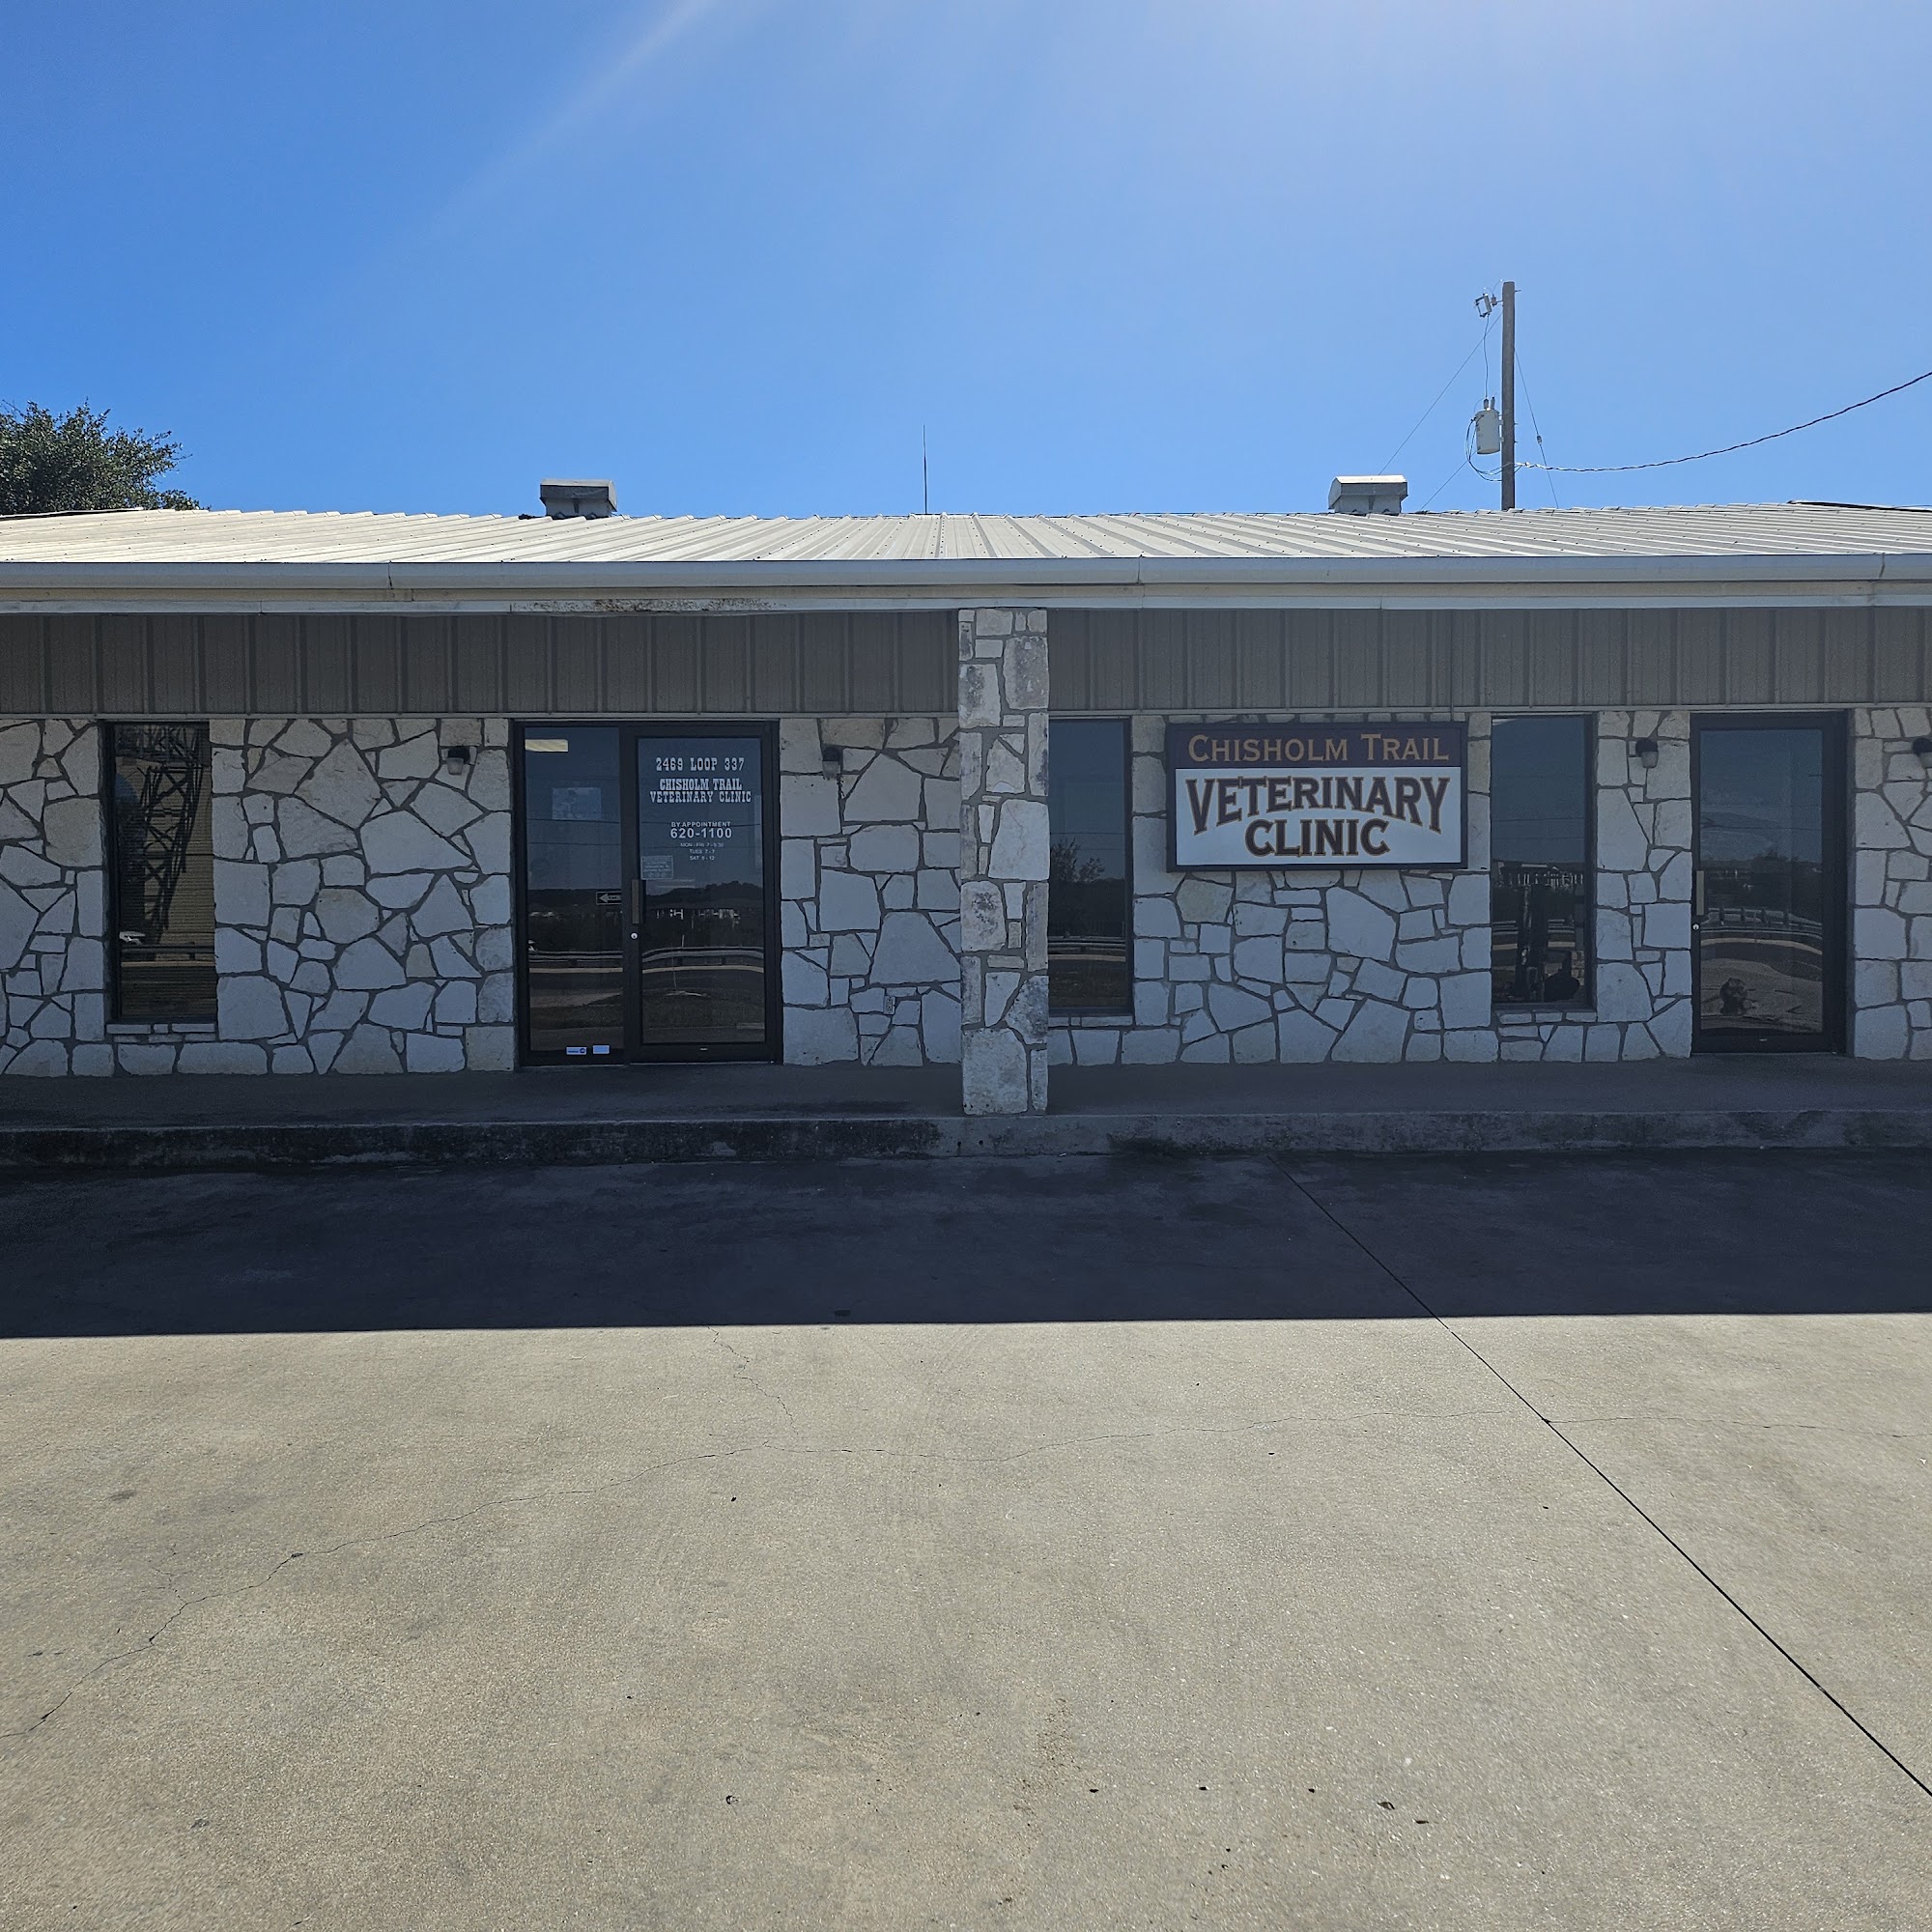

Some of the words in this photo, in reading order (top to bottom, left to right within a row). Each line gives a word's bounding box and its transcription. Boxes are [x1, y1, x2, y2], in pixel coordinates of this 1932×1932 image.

[1188, 733, 1348, 762] CHISHOLM
[1360, 732, 1450, 761] TRAIL
[656, 757, 683, 771] 2469
[690, 757, 718, 771] LOOP
[724, 757, 745, 771] 337
[659, 778, 709, 790] CHISHOLM
[713, 778, 743, 790] TRAIL
[649, 791, 714, 803] VETERINARY
[719, 791, 752, 803] CLINIC
[1185, 776, 1450, 836] VETERINARY
[670, 828, 732, 838] 620-1100
[1244, 818, 1391, 858] CLINIC
